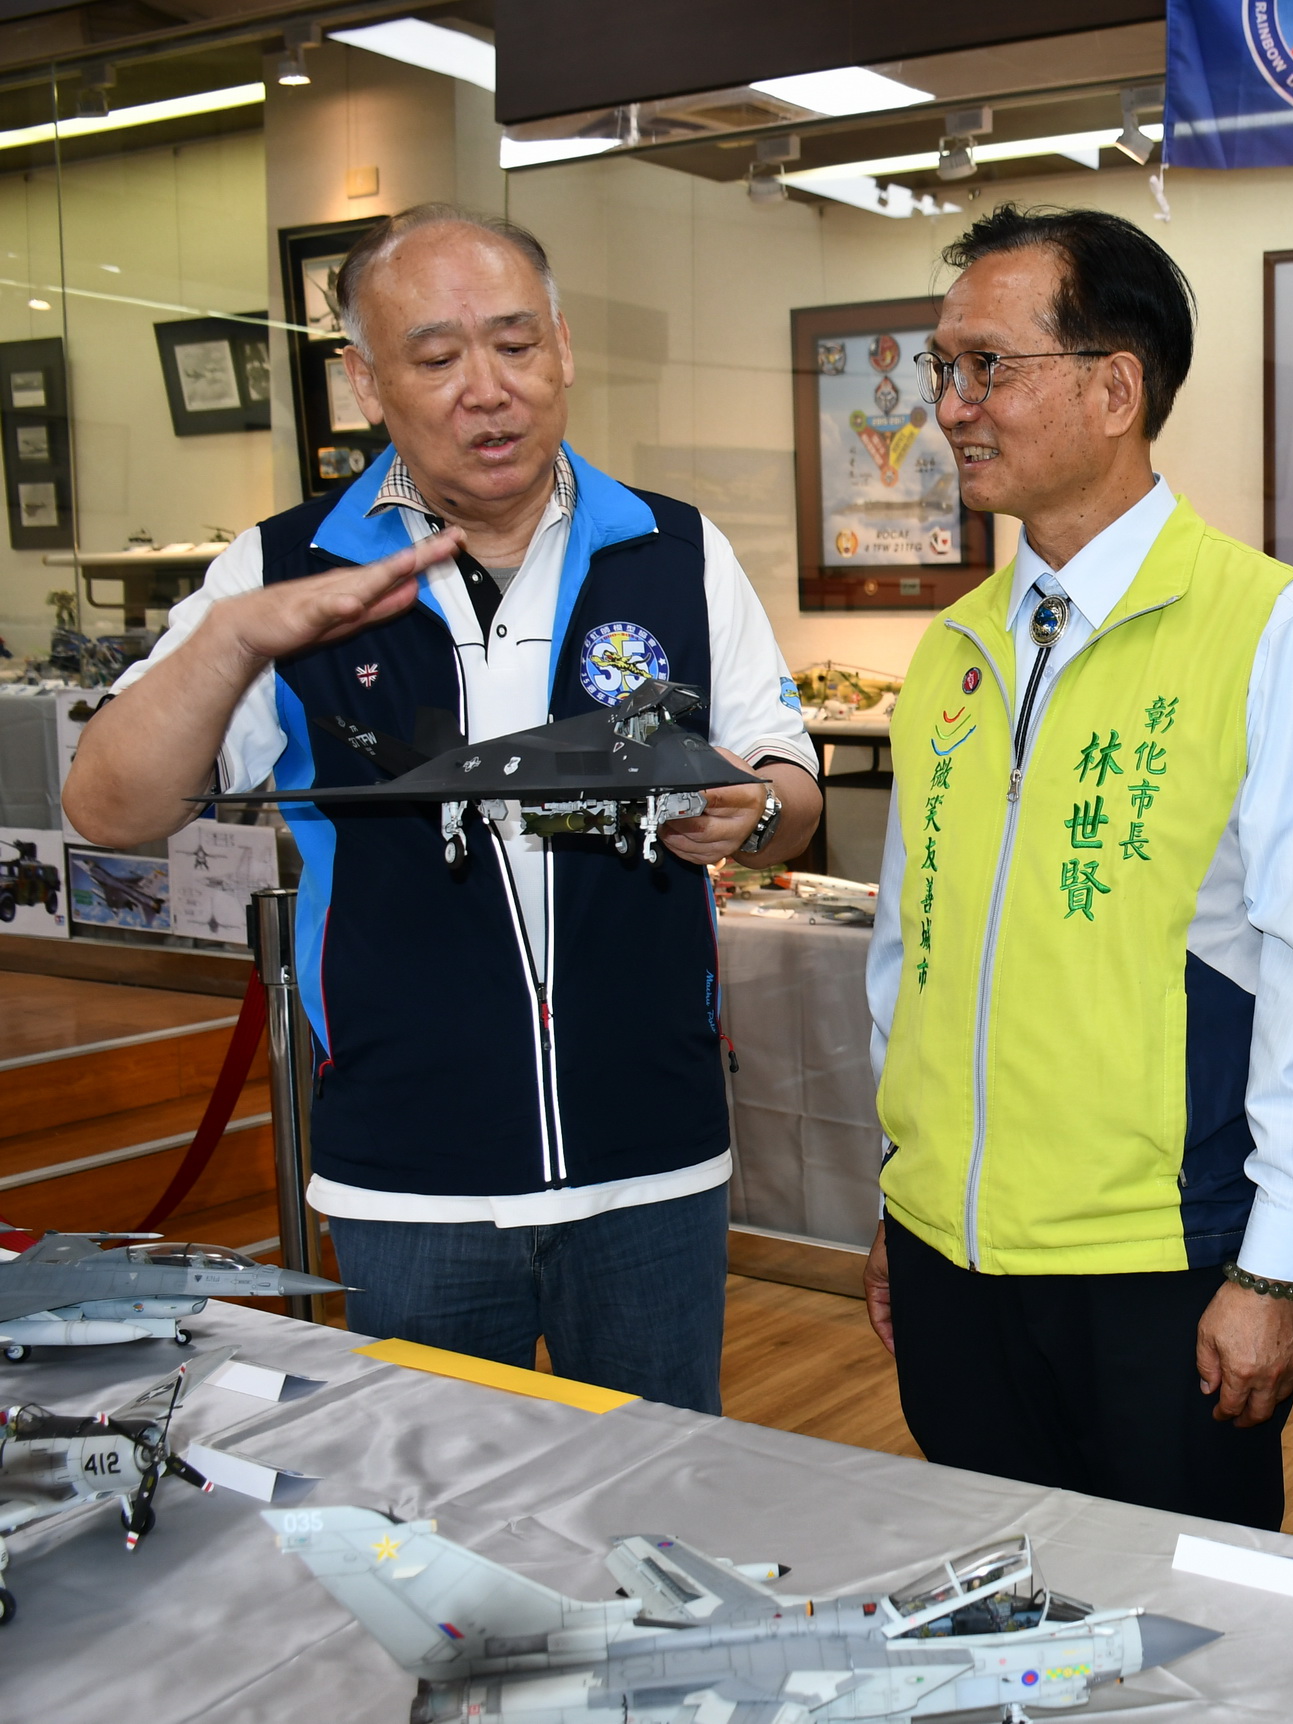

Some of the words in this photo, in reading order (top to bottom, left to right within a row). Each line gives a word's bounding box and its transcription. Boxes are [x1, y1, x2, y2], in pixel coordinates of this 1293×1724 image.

[1254, 2, 1287, 72] RAINBOW
[1059, 729, 1124, 922] 林世賢
[1118, 695, 1179, 861] 彰化市長
[916, 757, 953, 995] 微笑友善城市
[84, 1451, 122, 1476] 412
[284, 1510, 324, 1533] 035
